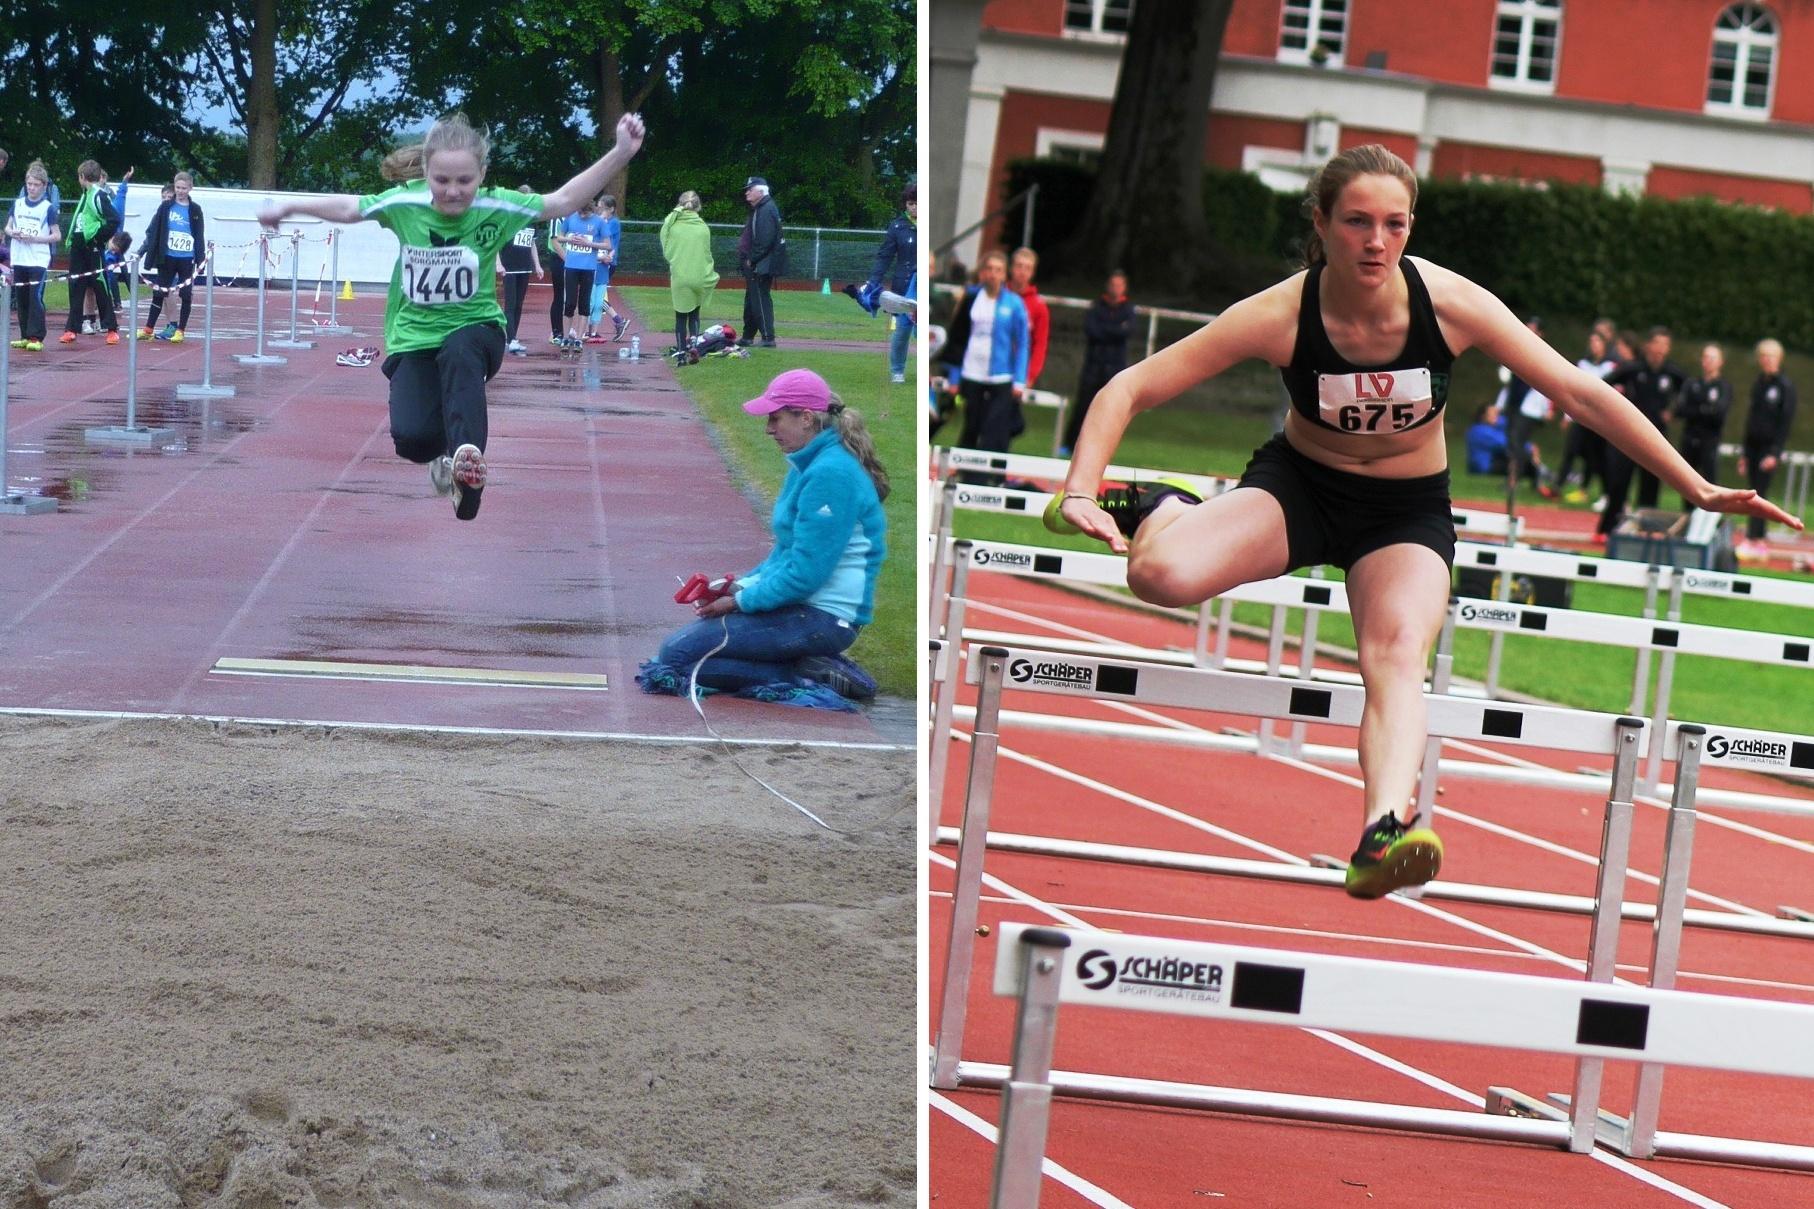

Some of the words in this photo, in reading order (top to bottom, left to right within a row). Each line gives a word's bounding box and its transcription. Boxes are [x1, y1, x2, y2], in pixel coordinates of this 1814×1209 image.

[169, 237, 192, 251] 1428
[405, 264, 474, 302] 1440
[1339, 404, 1414, 431] 675
[1034, 662, 1092, 680] SCHÄPER
[1730, 739, 1787, 756] SCHÄPER
[1119, 955, 1223, 985] SCHÄPER
